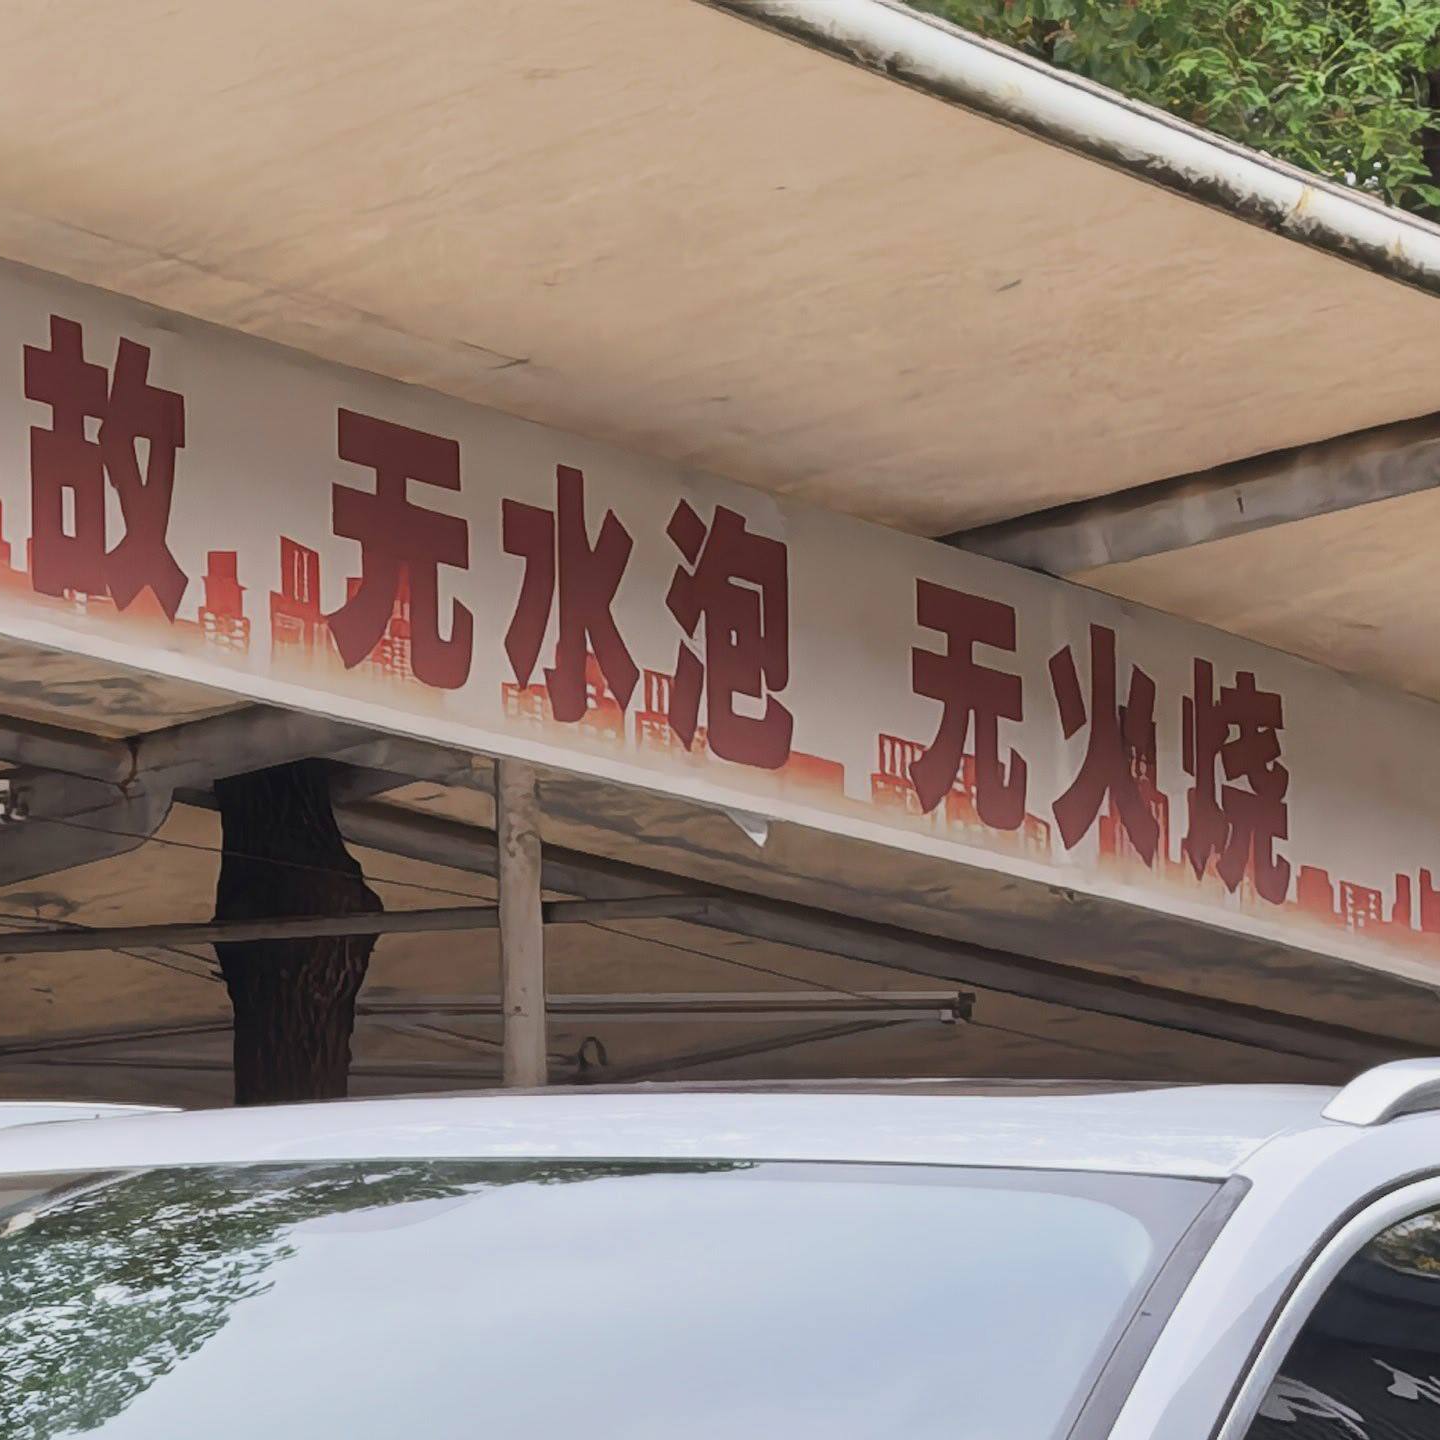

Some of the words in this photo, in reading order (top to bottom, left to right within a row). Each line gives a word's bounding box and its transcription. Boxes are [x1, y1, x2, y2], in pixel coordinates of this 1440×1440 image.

[326, 407, 794, 769] 无水泡
[910, 577, 1291, 905] 无火烧
